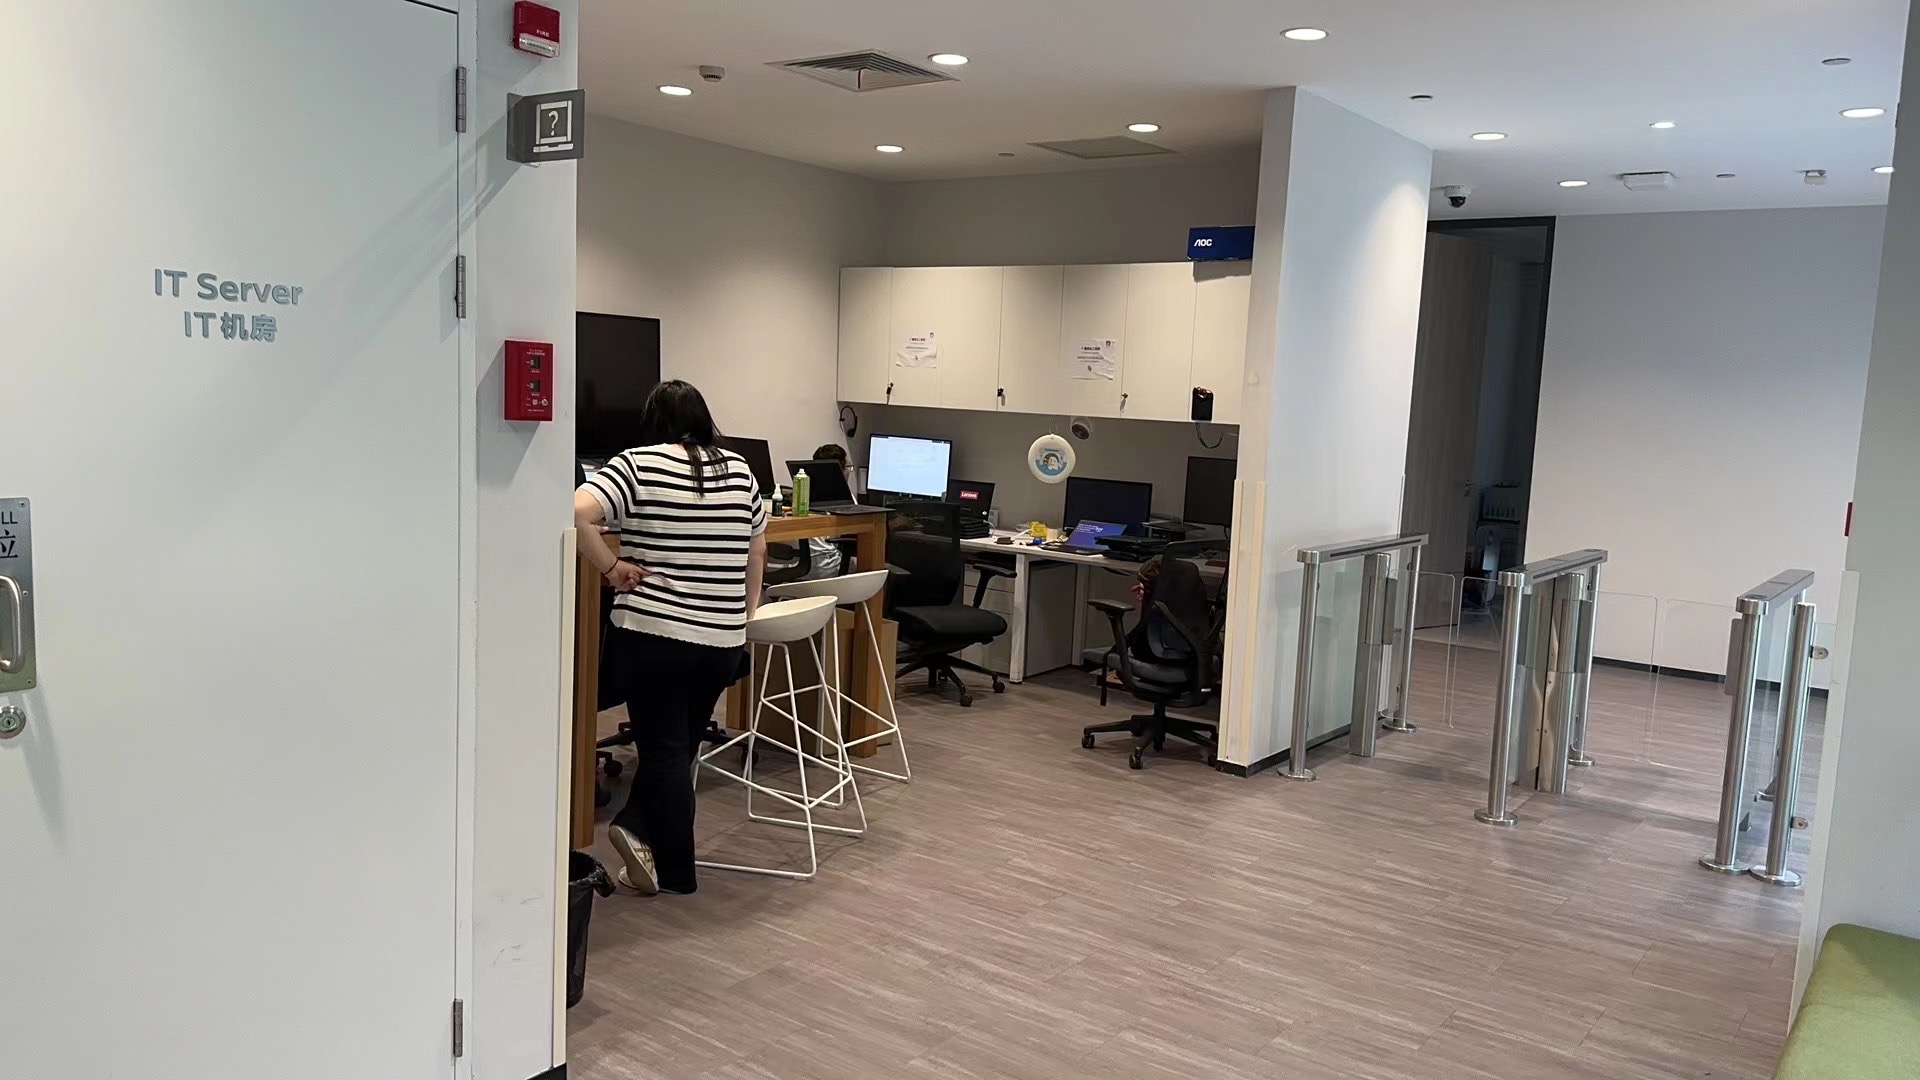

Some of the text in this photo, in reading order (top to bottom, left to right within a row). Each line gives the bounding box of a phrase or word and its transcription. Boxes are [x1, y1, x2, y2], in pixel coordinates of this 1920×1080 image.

[536, 29, 550, 37] FIRE
[548, 110, 559, 136] ?
[1193, 238, 1213, 247] AOC
[154, 268, 303, 305] IT Server
